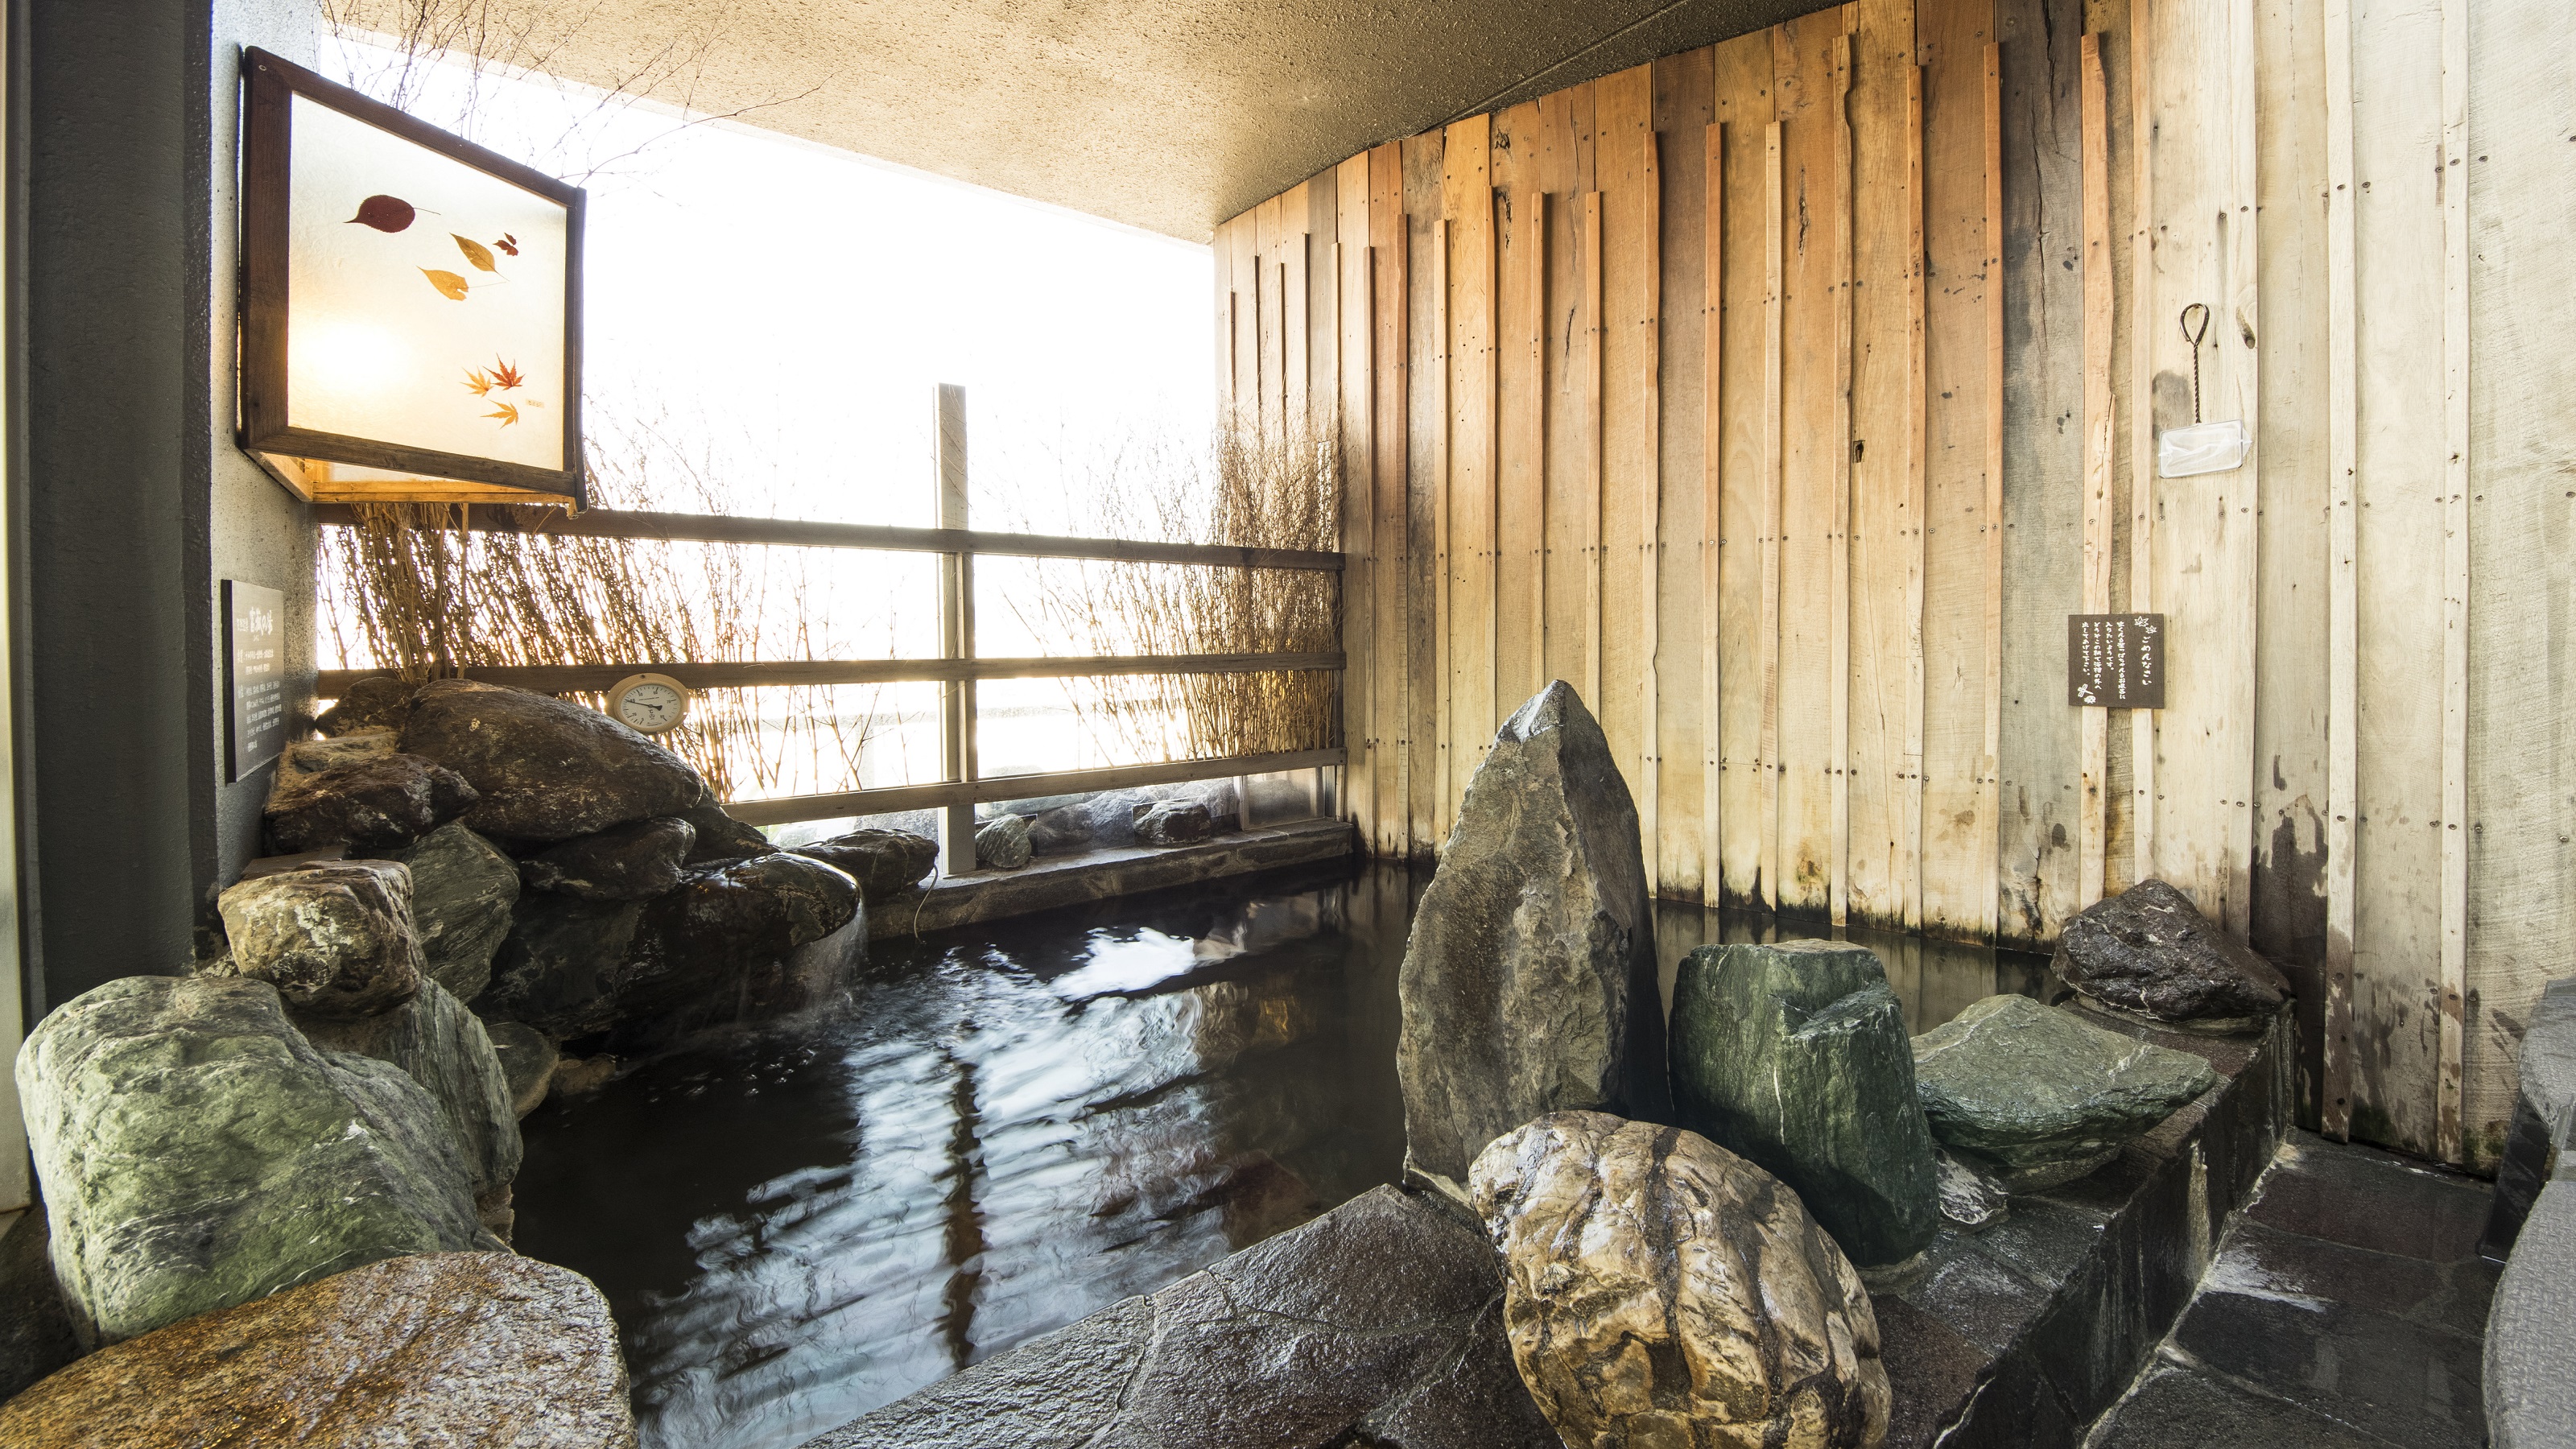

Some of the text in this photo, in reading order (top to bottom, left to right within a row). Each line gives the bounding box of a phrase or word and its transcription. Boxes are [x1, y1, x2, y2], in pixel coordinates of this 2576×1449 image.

[2082, 621, 2091, 676] 出してあげて下さい。
[2105, 621, 2115, 671] 入りたいようです。
[2140, 636, 2153, 686] ごめんなさい
